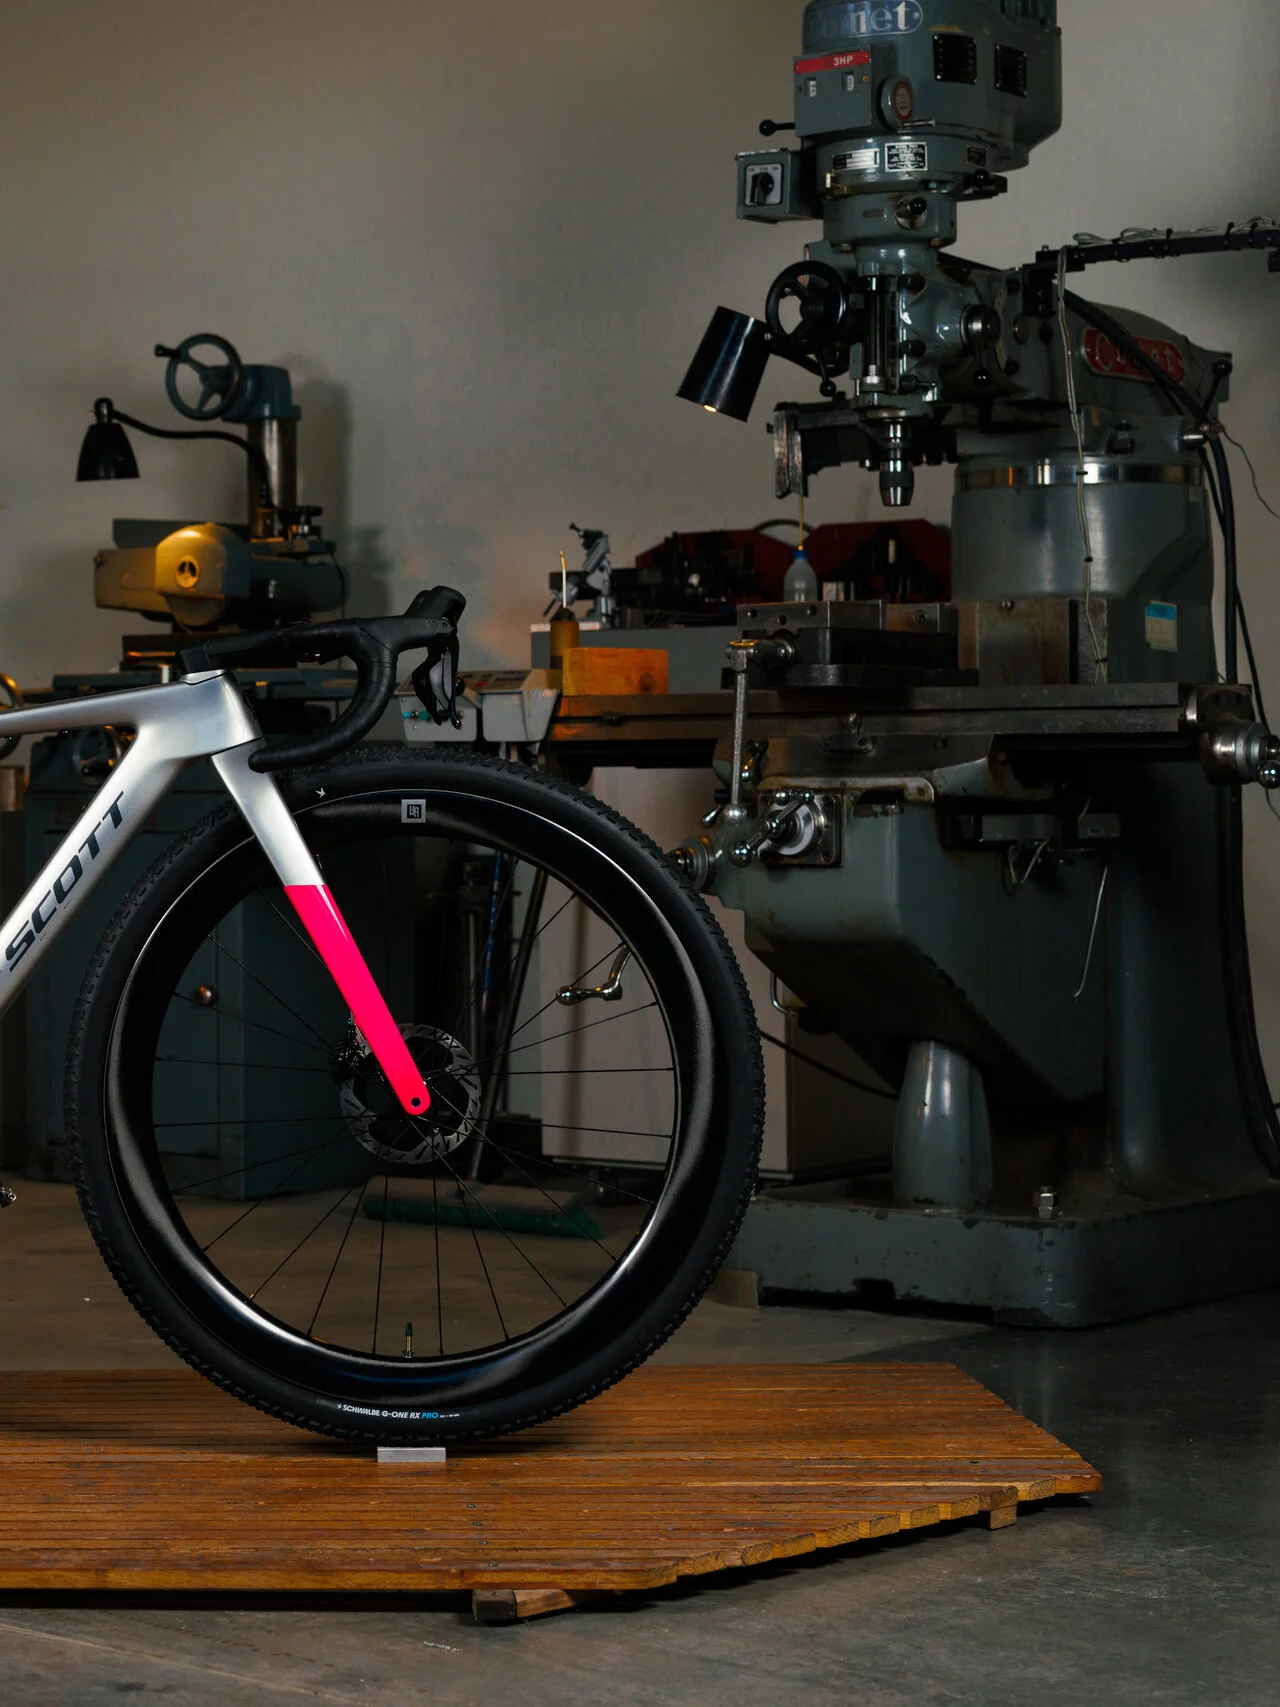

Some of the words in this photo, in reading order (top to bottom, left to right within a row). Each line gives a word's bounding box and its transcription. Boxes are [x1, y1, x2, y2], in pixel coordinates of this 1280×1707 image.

[833, 55, 854, 66] 3HP
[5, 789, 127, 972] SCOTT
[342, 1404, 380, 1416] SCHWALBE
[381, 1410, 409, 1419] G-ONE
